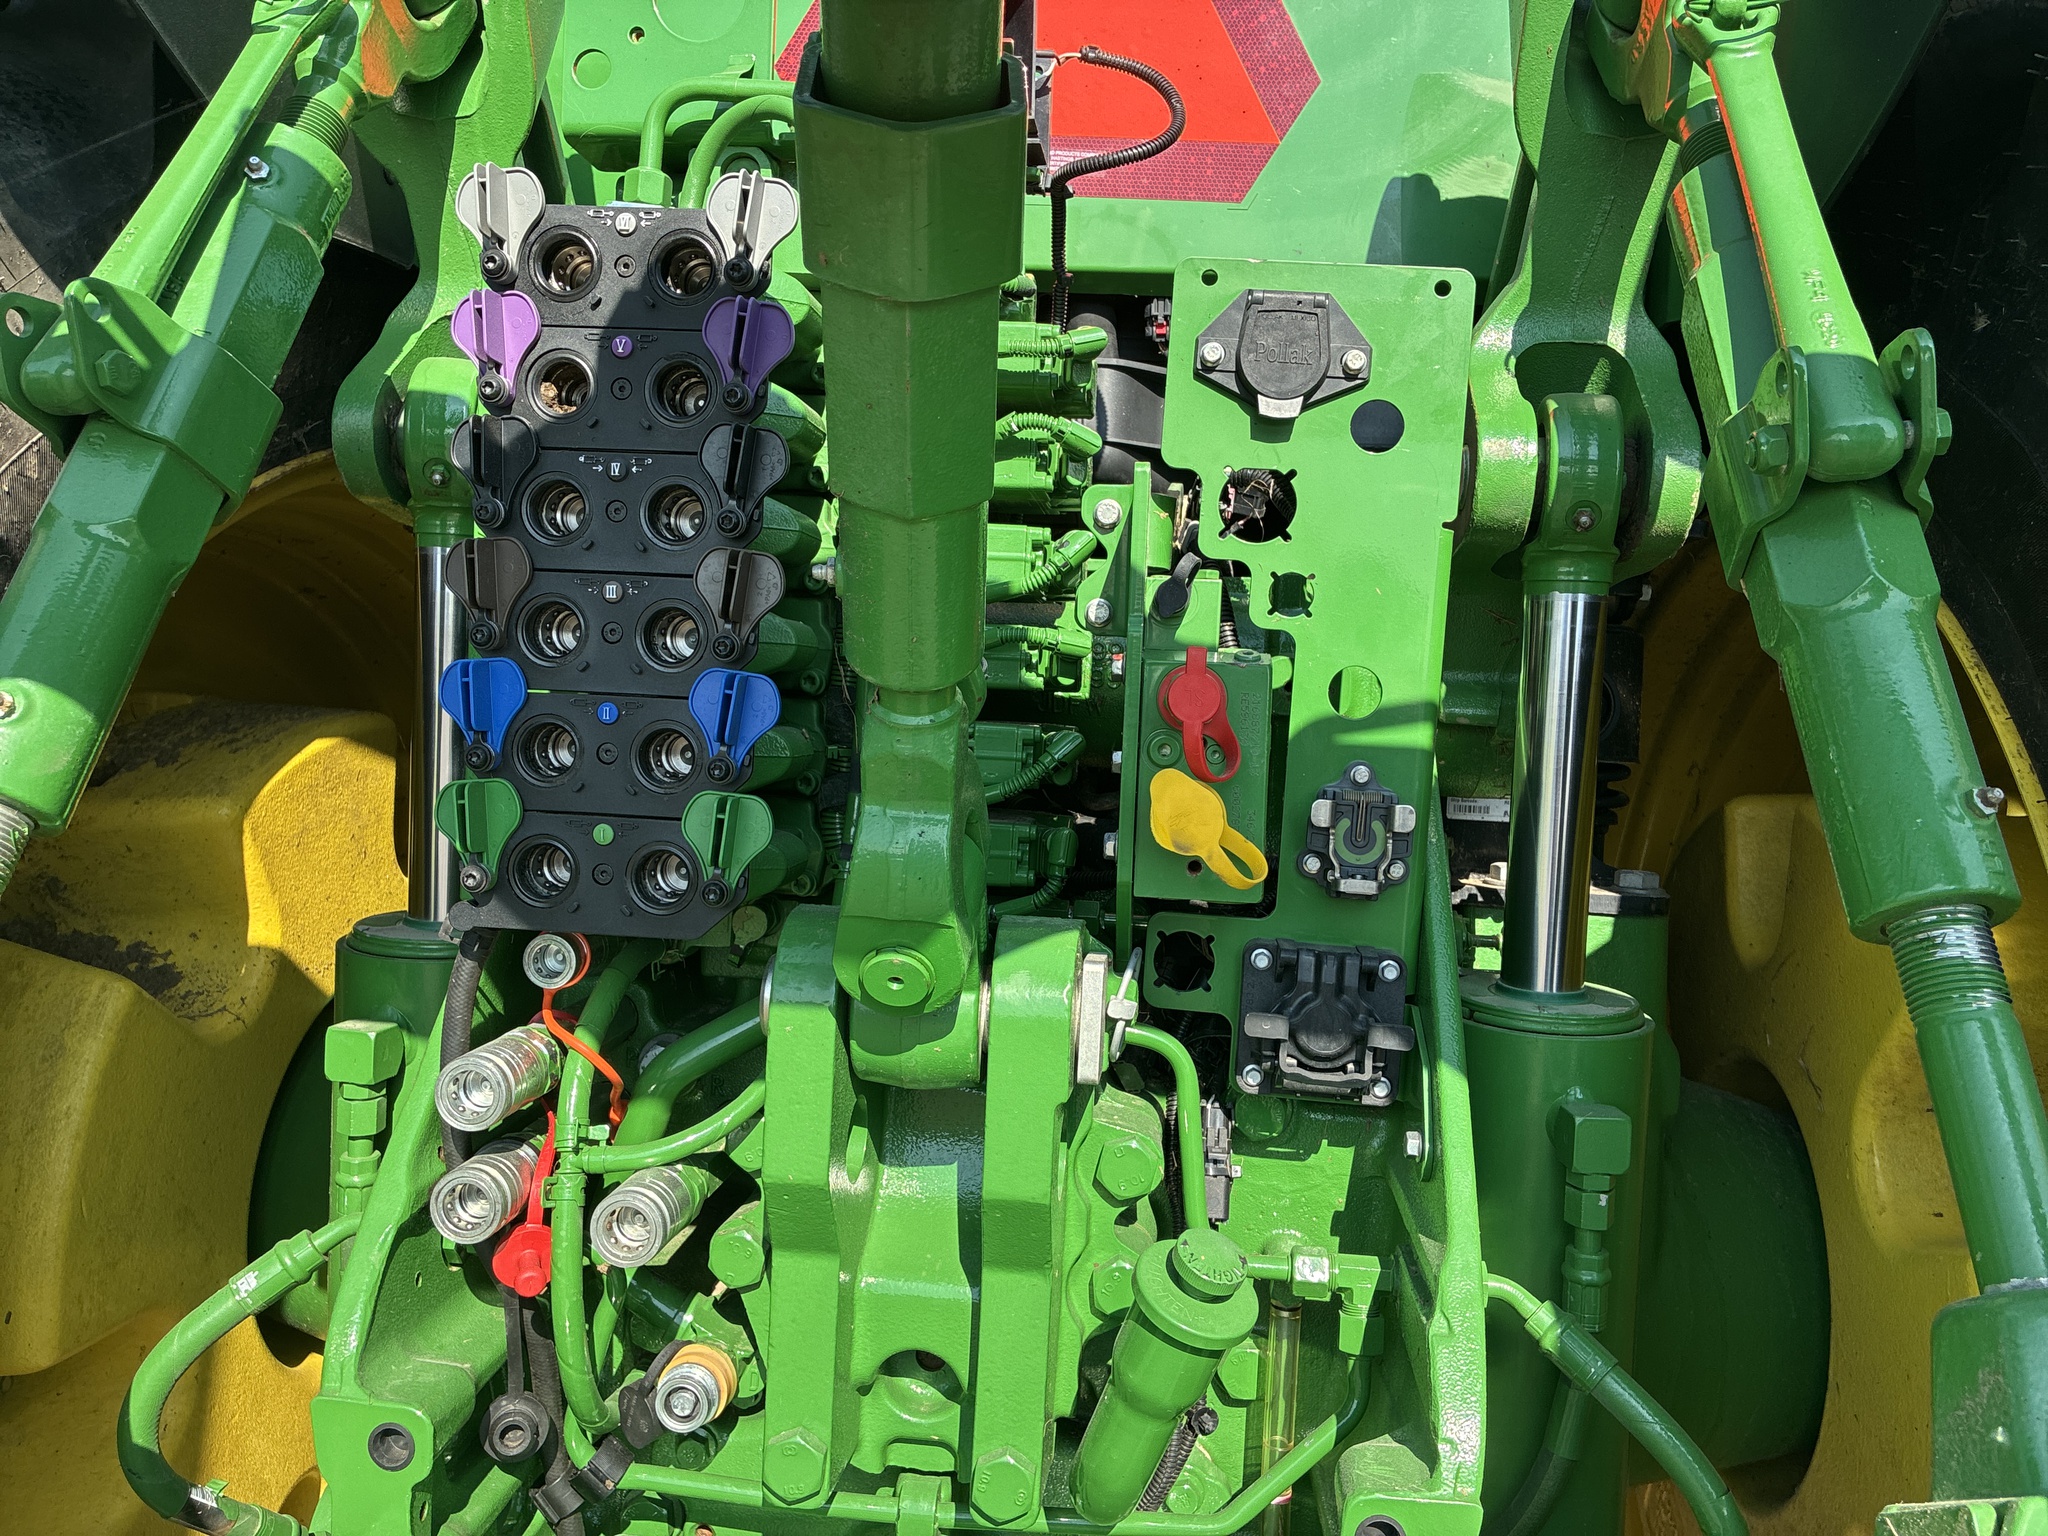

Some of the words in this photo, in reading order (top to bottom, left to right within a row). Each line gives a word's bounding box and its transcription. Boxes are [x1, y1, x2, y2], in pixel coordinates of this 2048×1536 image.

[618, 216, 631, 232] VI
[615, 338, 627, 354] V
[1254, 340, 1313, 366] Pollak
[610, 462, 621, 476] IV
[605, 584, 617, 598] III
[602, 706, 610, 720] II
[599, 828, 605, 841] I
[1117, 1173, 1145, 1192] 10.9
[1101, 1271, 1123, 1297] 10.9
[783, 1483, 805, 1496] 10.9
